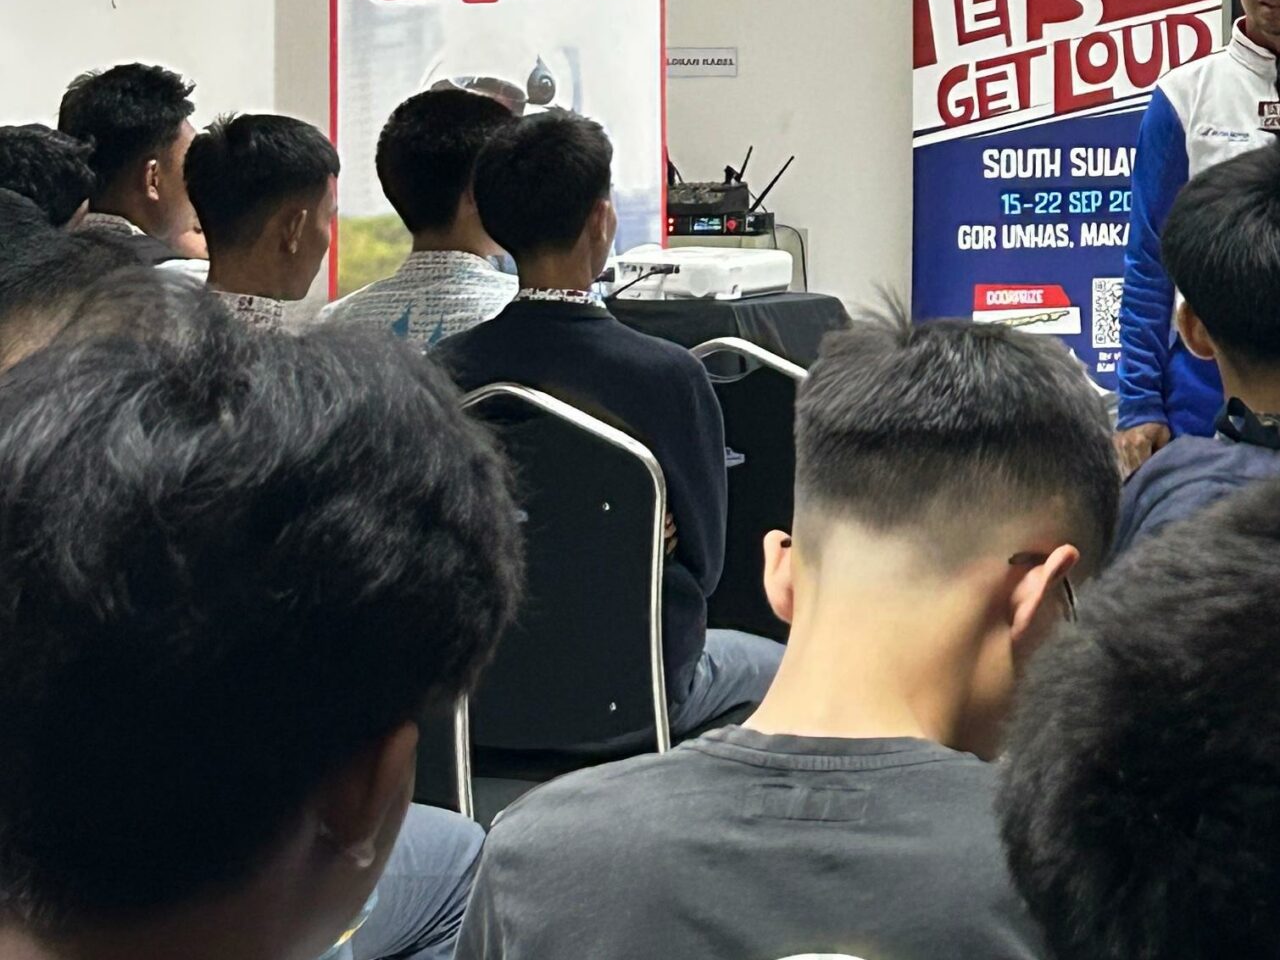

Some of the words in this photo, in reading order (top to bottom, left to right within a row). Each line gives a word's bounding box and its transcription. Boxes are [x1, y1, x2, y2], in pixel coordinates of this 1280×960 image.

[938, 46, 1047, 127] GET
[1053, 14, 1213, 114] LOUD
[982, 148, 1062, 179] SOUTH
[1001, 191, 1062, 214] 15-22
[1068, 190, 1103, 213] SEP
[1108, 190, 1132, 212] 20
[957, 225, 997, 250] GOR
[1001, 223, 1075, 249] UNHAS,
